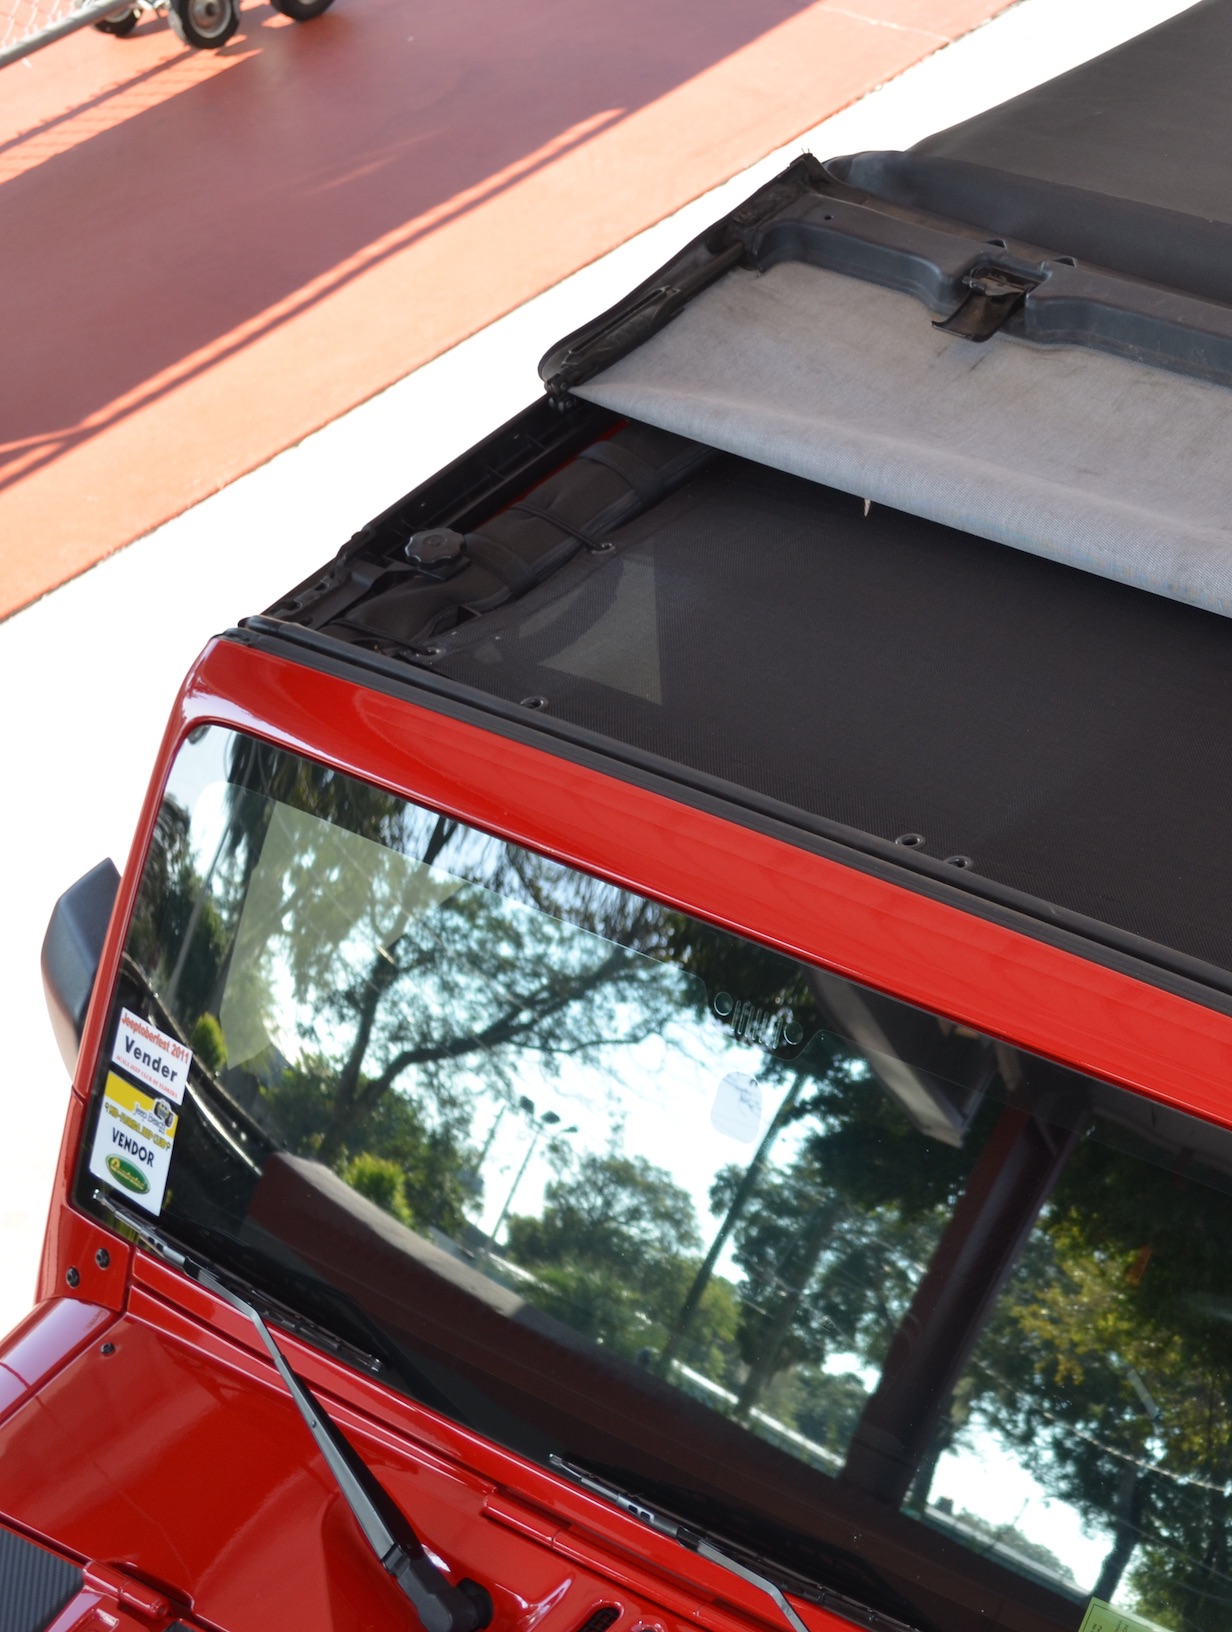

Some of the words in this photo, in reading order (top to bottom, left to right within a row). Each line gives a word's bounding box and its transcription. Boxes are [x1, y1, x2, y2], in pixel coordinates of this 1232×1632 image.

[122, 1013, 170, 1053] Jeeptoberfest
[171, 1044, 189, 1064] 2011
[125, 1034, 178, 1082] Vender
[133, 1104, 148, 1121] Jeep
[112, 1127, 155, 1168] VENDOR
